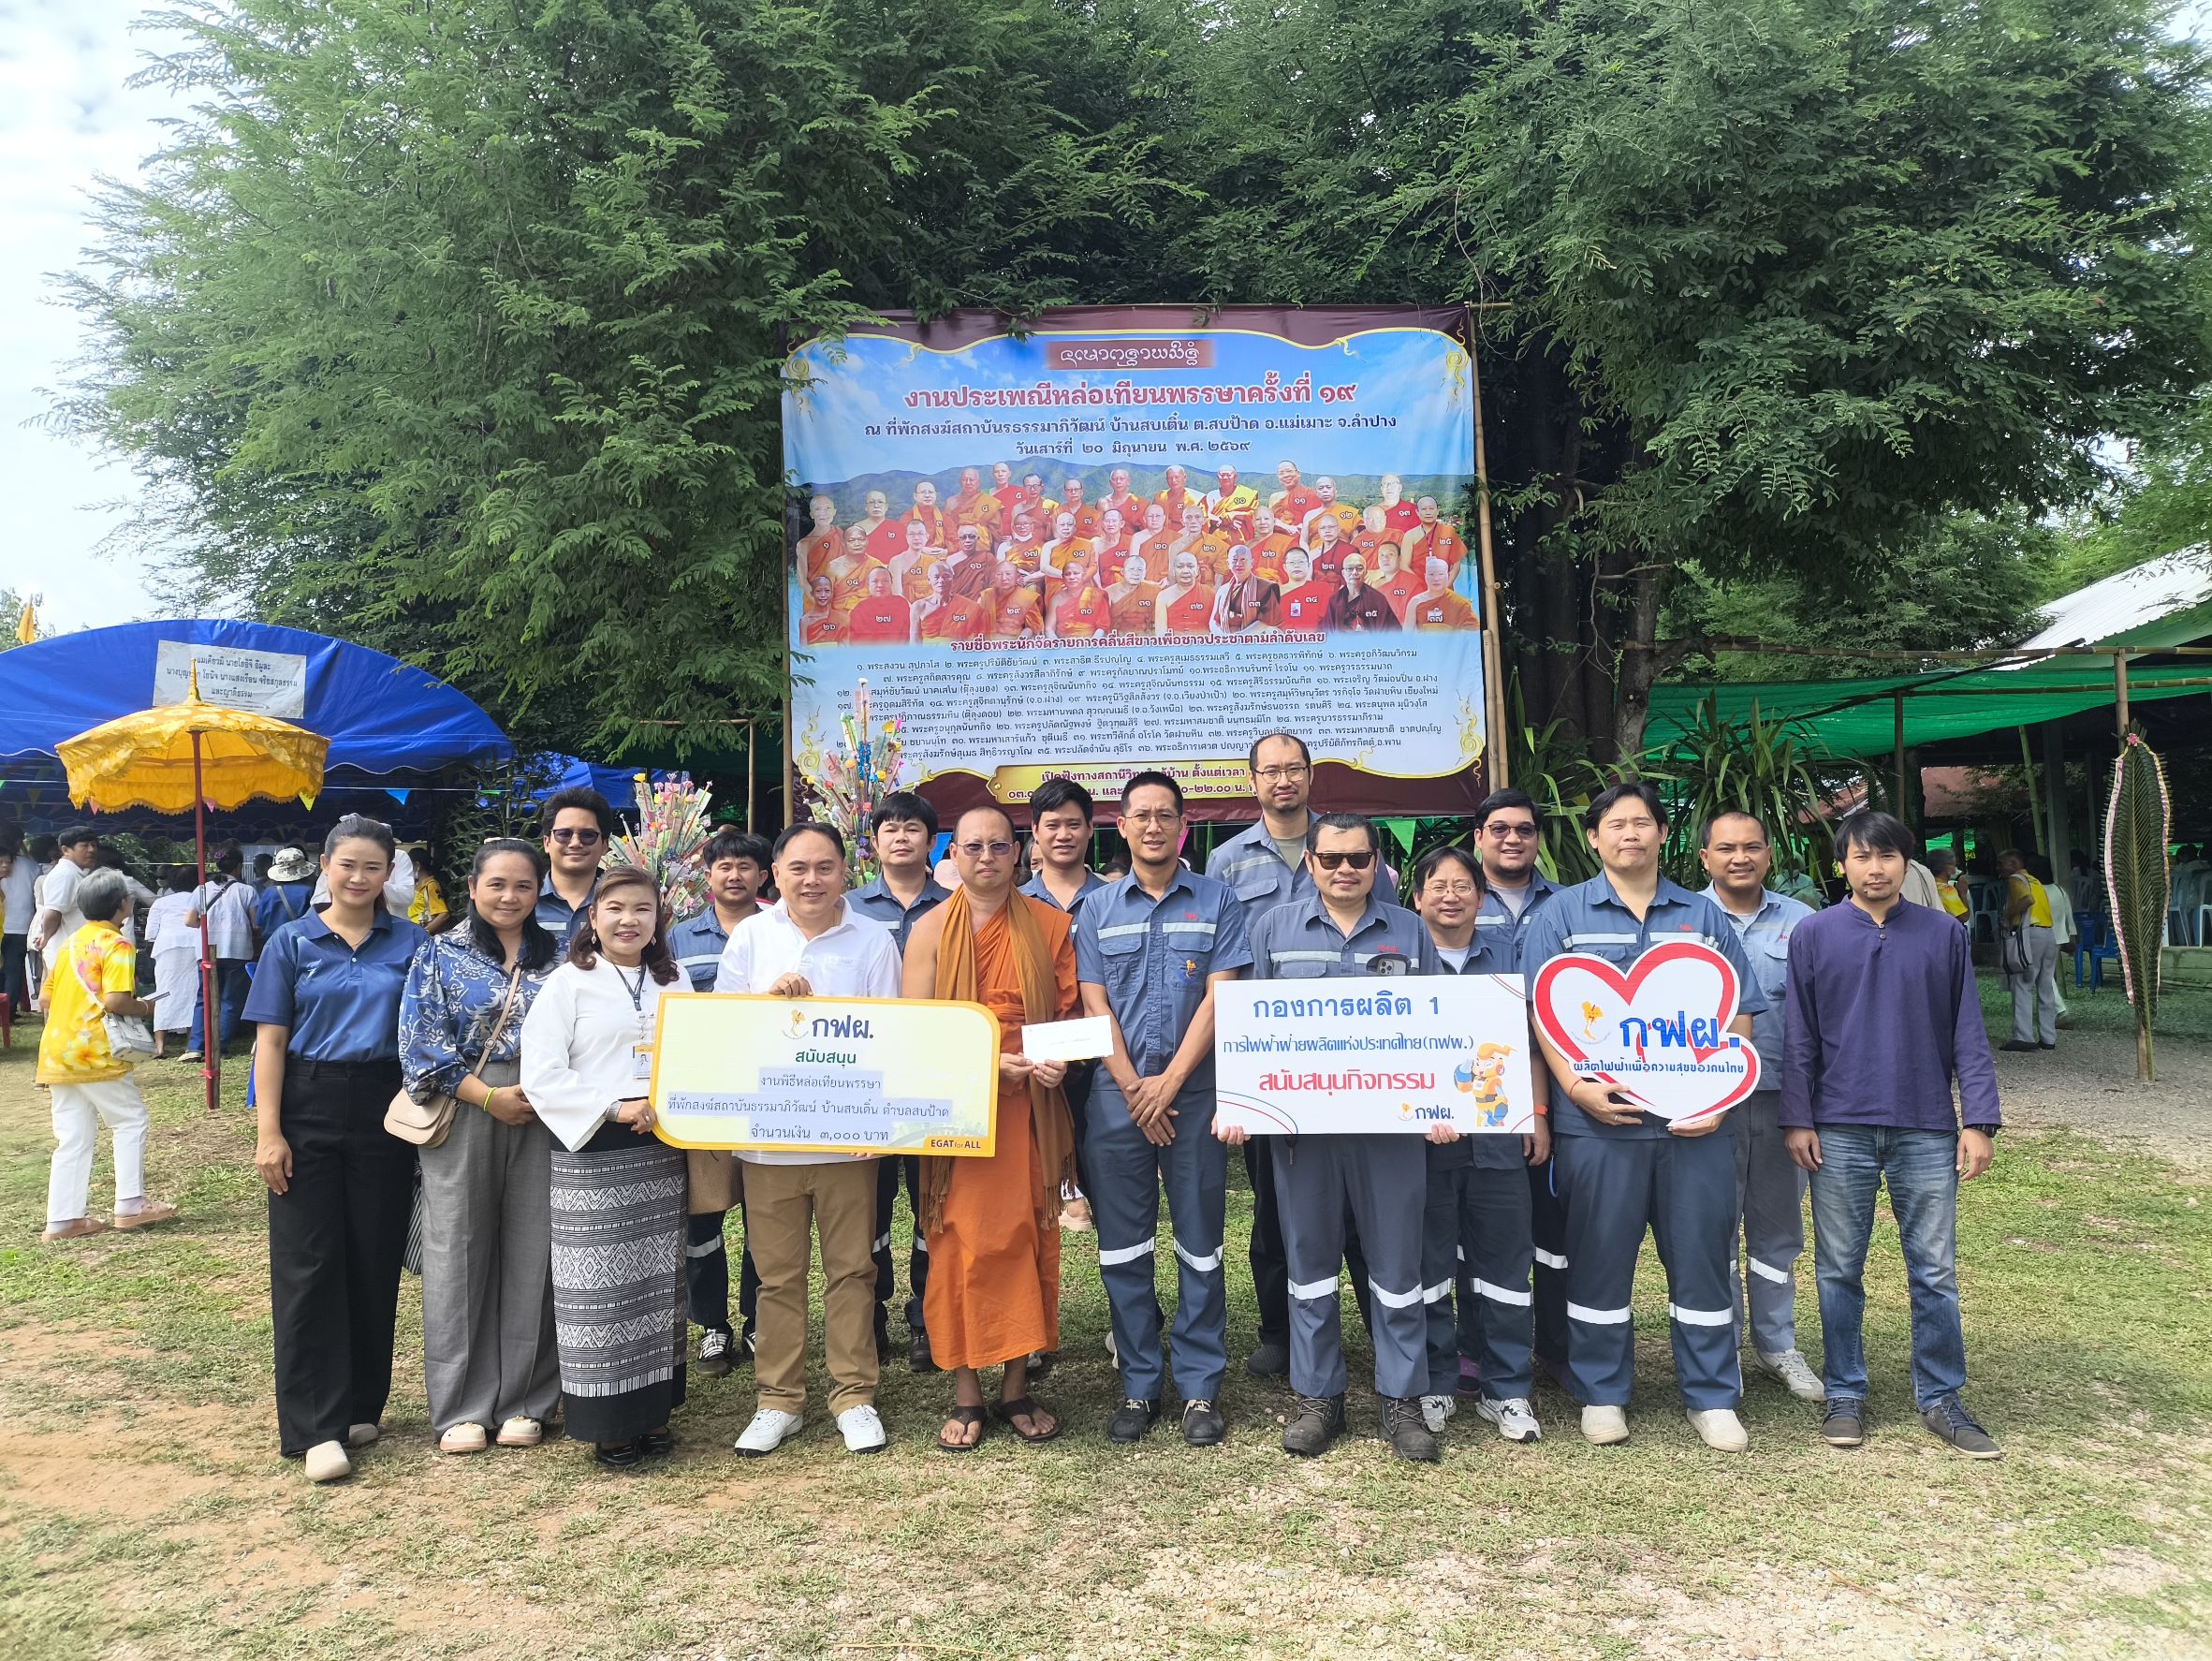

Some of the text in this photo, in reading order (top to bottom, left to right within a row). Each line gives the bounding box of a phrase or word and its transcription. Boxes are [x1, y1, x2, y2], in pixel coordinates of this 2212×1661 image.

[904, 372, 1356, 407] งานประเพณีหล่อเทียนพรรษาครั้งที่ ๑๙
[864, 425, 881, 436] ณ
[1194, 415, 1259, 432] ต.สบป้าด
[1265, 414, 1332, 430] อ.แม่เมาะ
[1338, 413, 1397, 429] จ.ลำปาง
[1016, 437, 1251, 457] วันเสาร์ที่ ๒๐ มิถุนายน พ.ศ. ๒๕๖๙
[1192, 765, 1246, 780] ตั้งแต่เวลา
[1252, 991, 1439, 1018] กองการผลิต 1
[812, 1014, 873, 1039] กฟผ.
[1619, 1010, 1740, 1048] กฟผ.
[1223, 1033, 1474, 1053] การไฟฟ้าฝ่ายผลิตแห่งประเทศไทย(กฟผ.)
[795, 1048, 857, 1067] สนับสนุน
[1574, 1057, 1744, 1076] ผลิตไฟฟ้าเพื่อความสุขของคนไทย
[760, 1074, 882, 1091] งานพิธีหล่อเทียนพรรษา
[1259, 1068, 1435, 1095] สนับสนุนกิจกรรม
[883, 1102, 949, 1118] ตำบลสบป้าด
[1414, 1104, 1455, 1120] กฟผ.
[820, 1131, 860, 1141] ๓,๐๐๐
[864, 1130, 888, 1141] บาท
